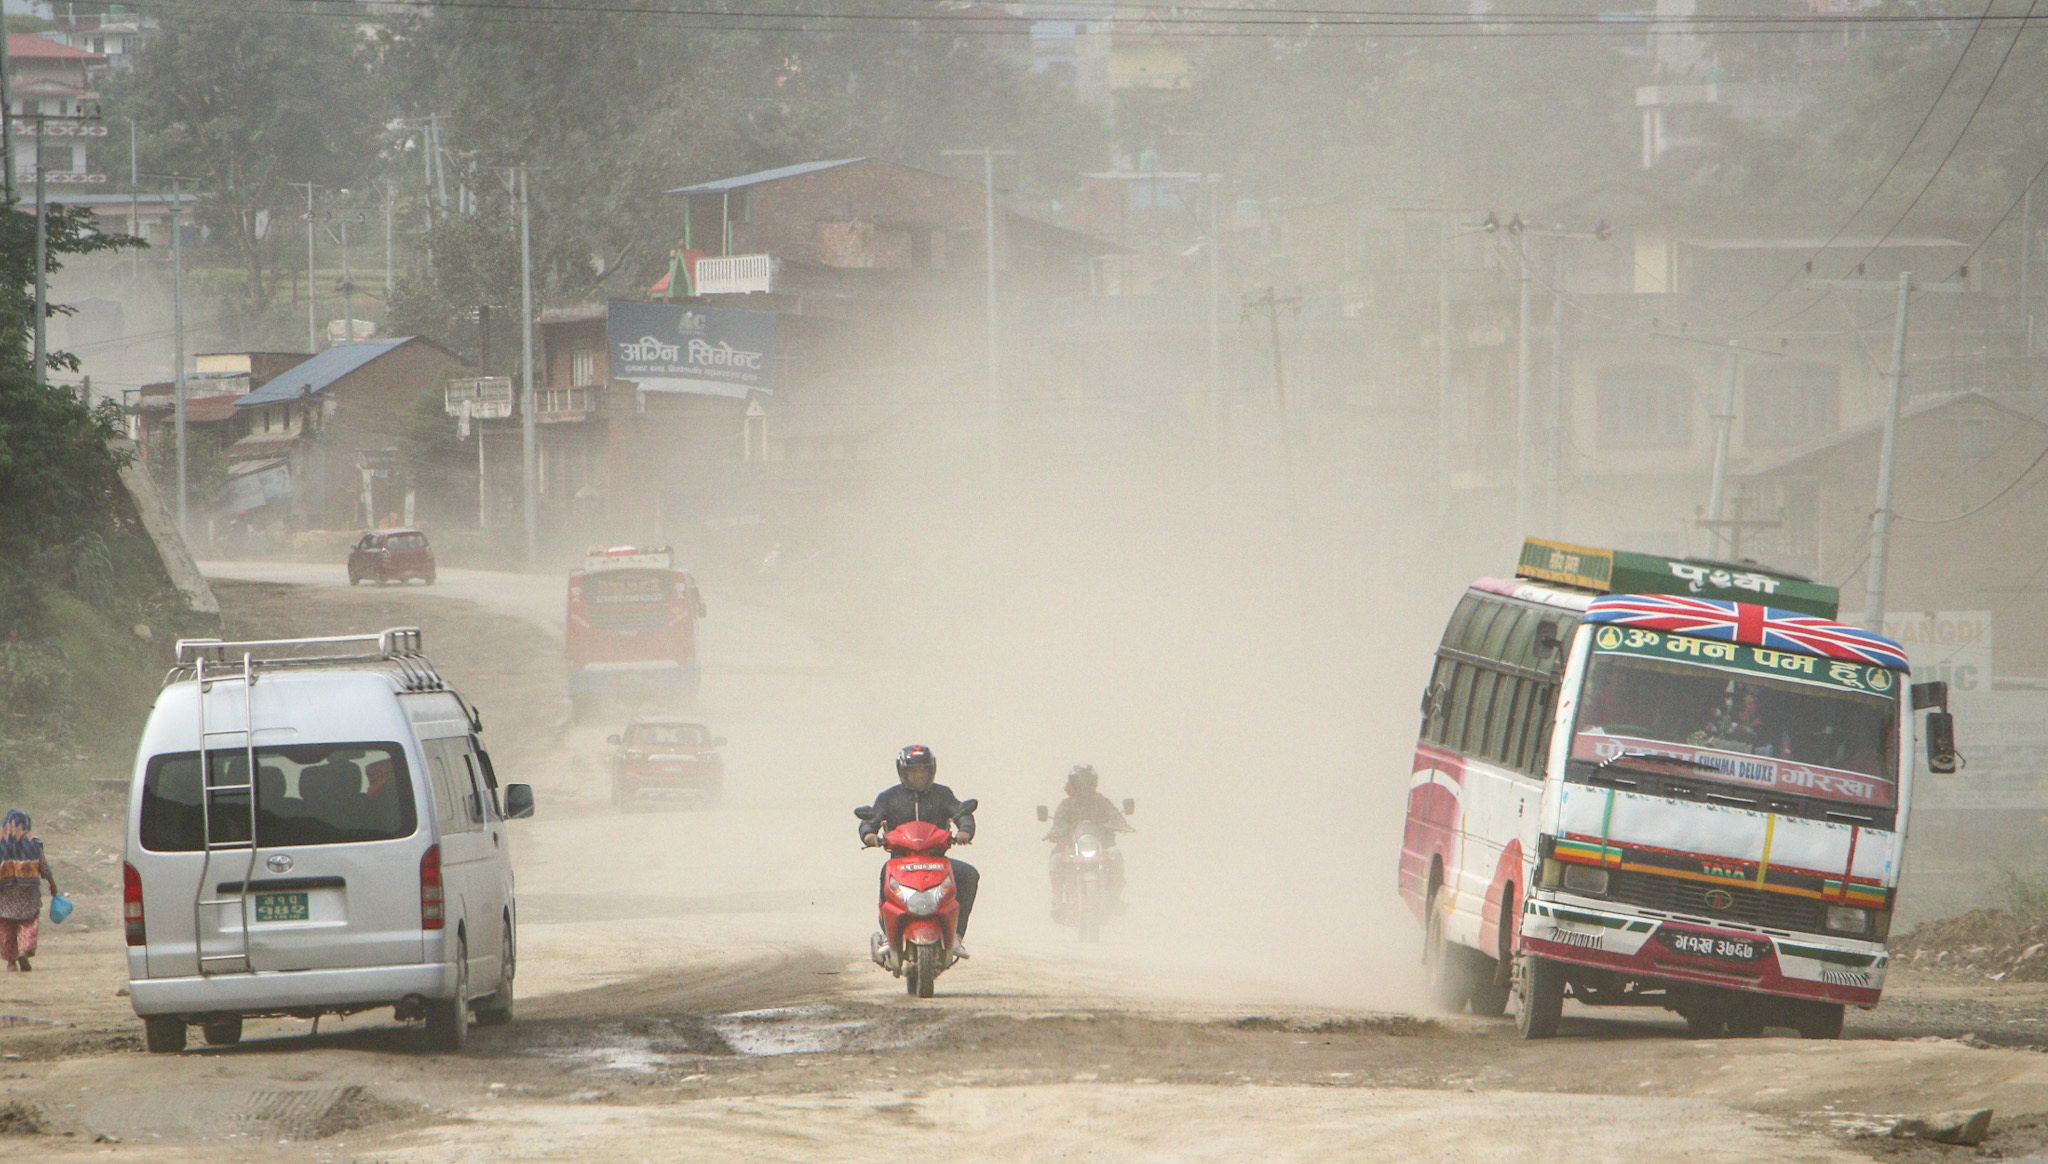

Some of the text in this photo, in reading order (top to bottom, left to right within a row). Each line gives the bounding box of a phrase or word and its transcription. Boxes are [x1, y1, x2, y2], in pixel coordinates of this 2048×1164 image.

[619, 336, 763, 370] अग्नि सिमेन्ट
[1851, 620, 1983, 643] YANGDI
[1666, 635, 1739, 661] मन
[1752, 648, 1818, 674] पम
[1738, 761, 1773, 782] DELUXE
[1782, 766, 1875, 798] गोरखा
[1701, 861, 1746, 880] TATA
